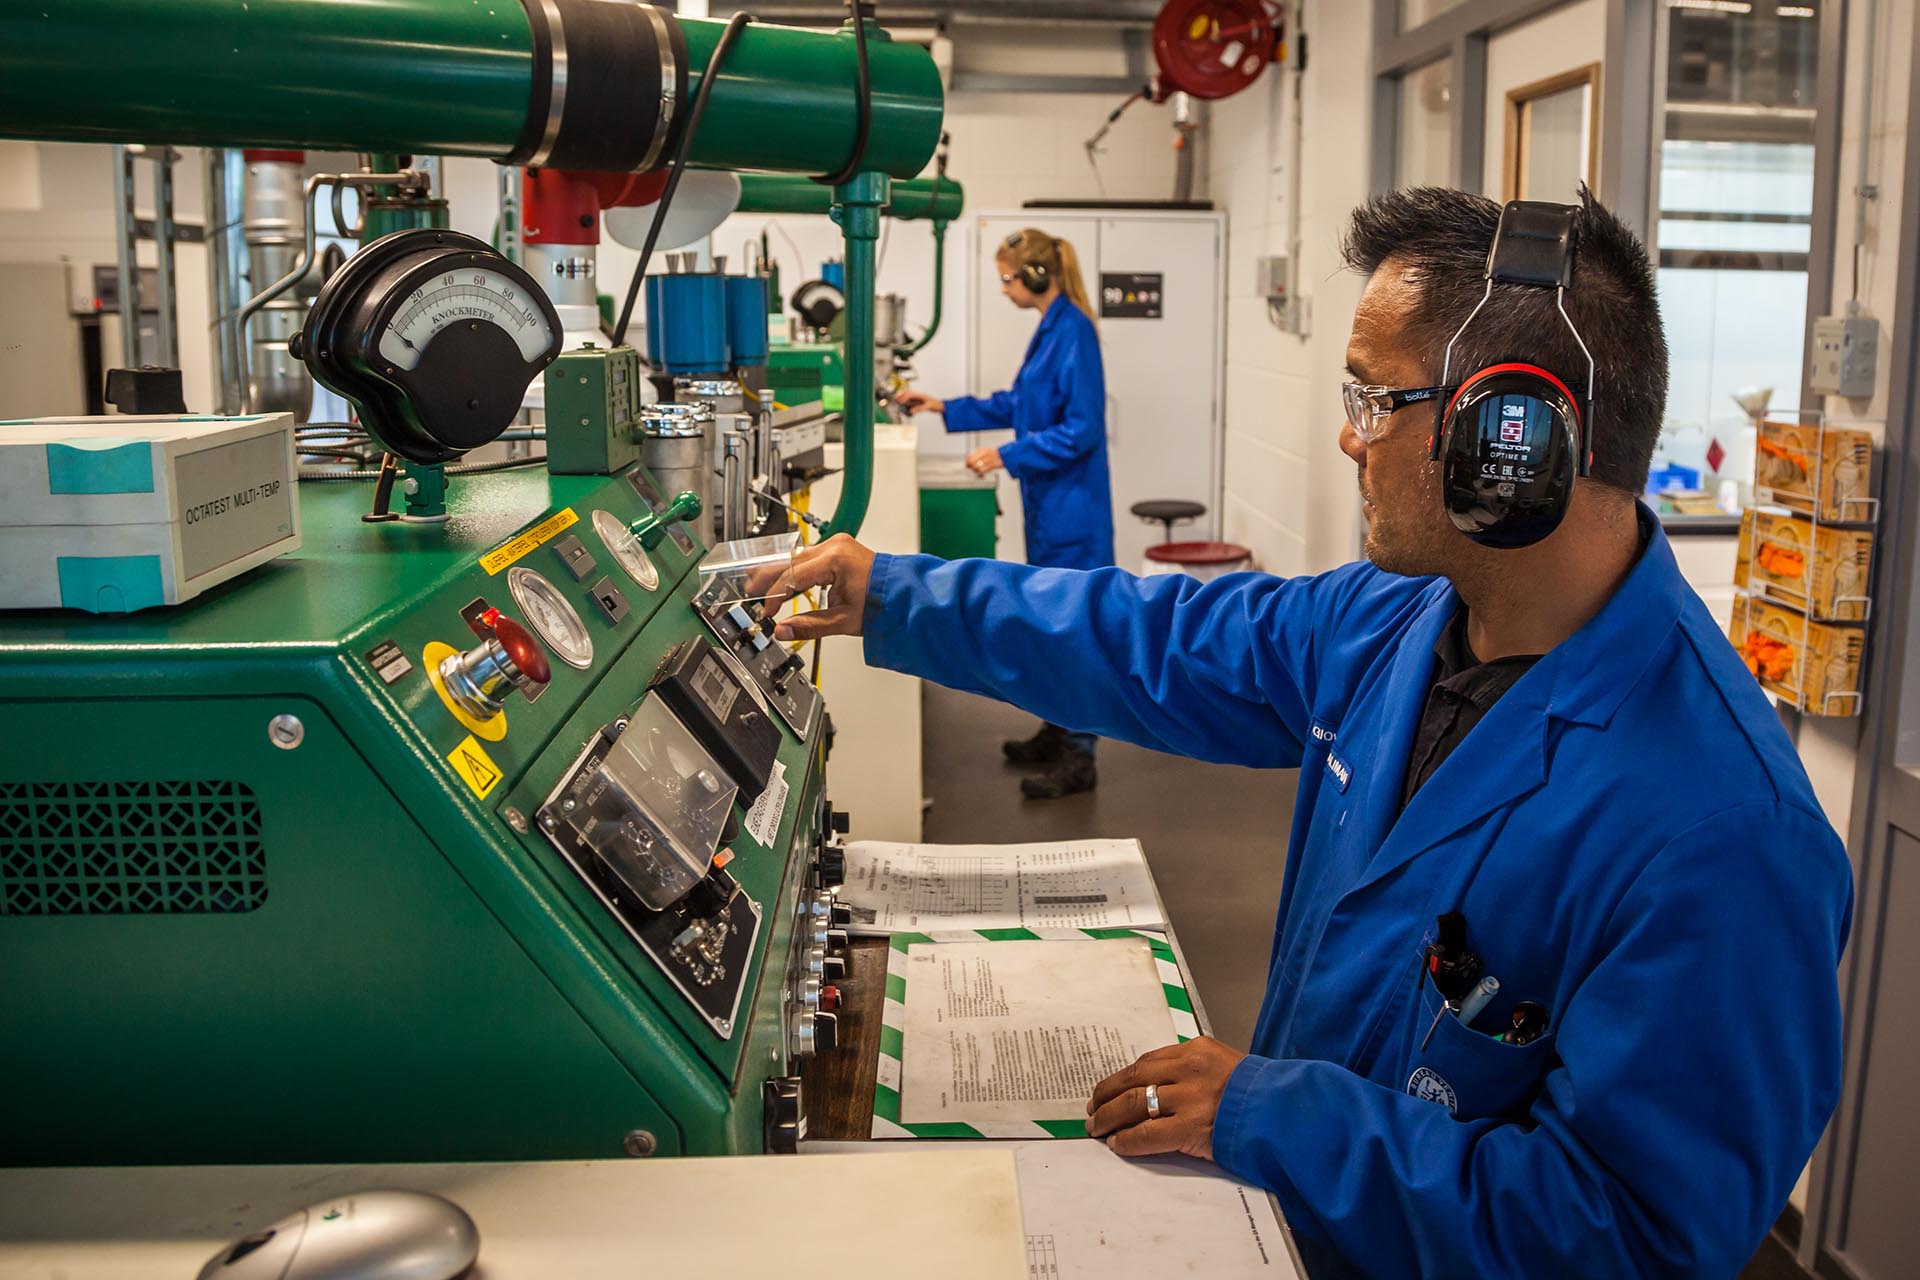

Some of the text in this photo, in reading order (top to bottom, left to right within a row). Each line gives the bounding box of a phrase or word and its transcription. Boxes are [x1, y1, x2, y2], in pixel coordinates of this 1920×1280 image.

[442, 275, 454, 287] 40
[473, 275, 486, 287] 60
[410, 288, 424, 304] 20
[502, 287, 515, 301] 80
[432, 306, 496, 325] KNOCKMETER
[521, 307, 537, 328] 100
[386, 322, 395, 331] 0
[1405, 391, 1430, 402] bollé
[1502, 405, 1524, 417] 3M
[1490, 442, 1532, 452] PELTOR
[1490, 451, 1519, 461] OPTIME
[1482, 463, 1497, 474] CE
[185, 480, 280, 525] OCTATEST MULTI-TEMP
[1410, 1070, 1456, 1108] BUREAU VERIT
